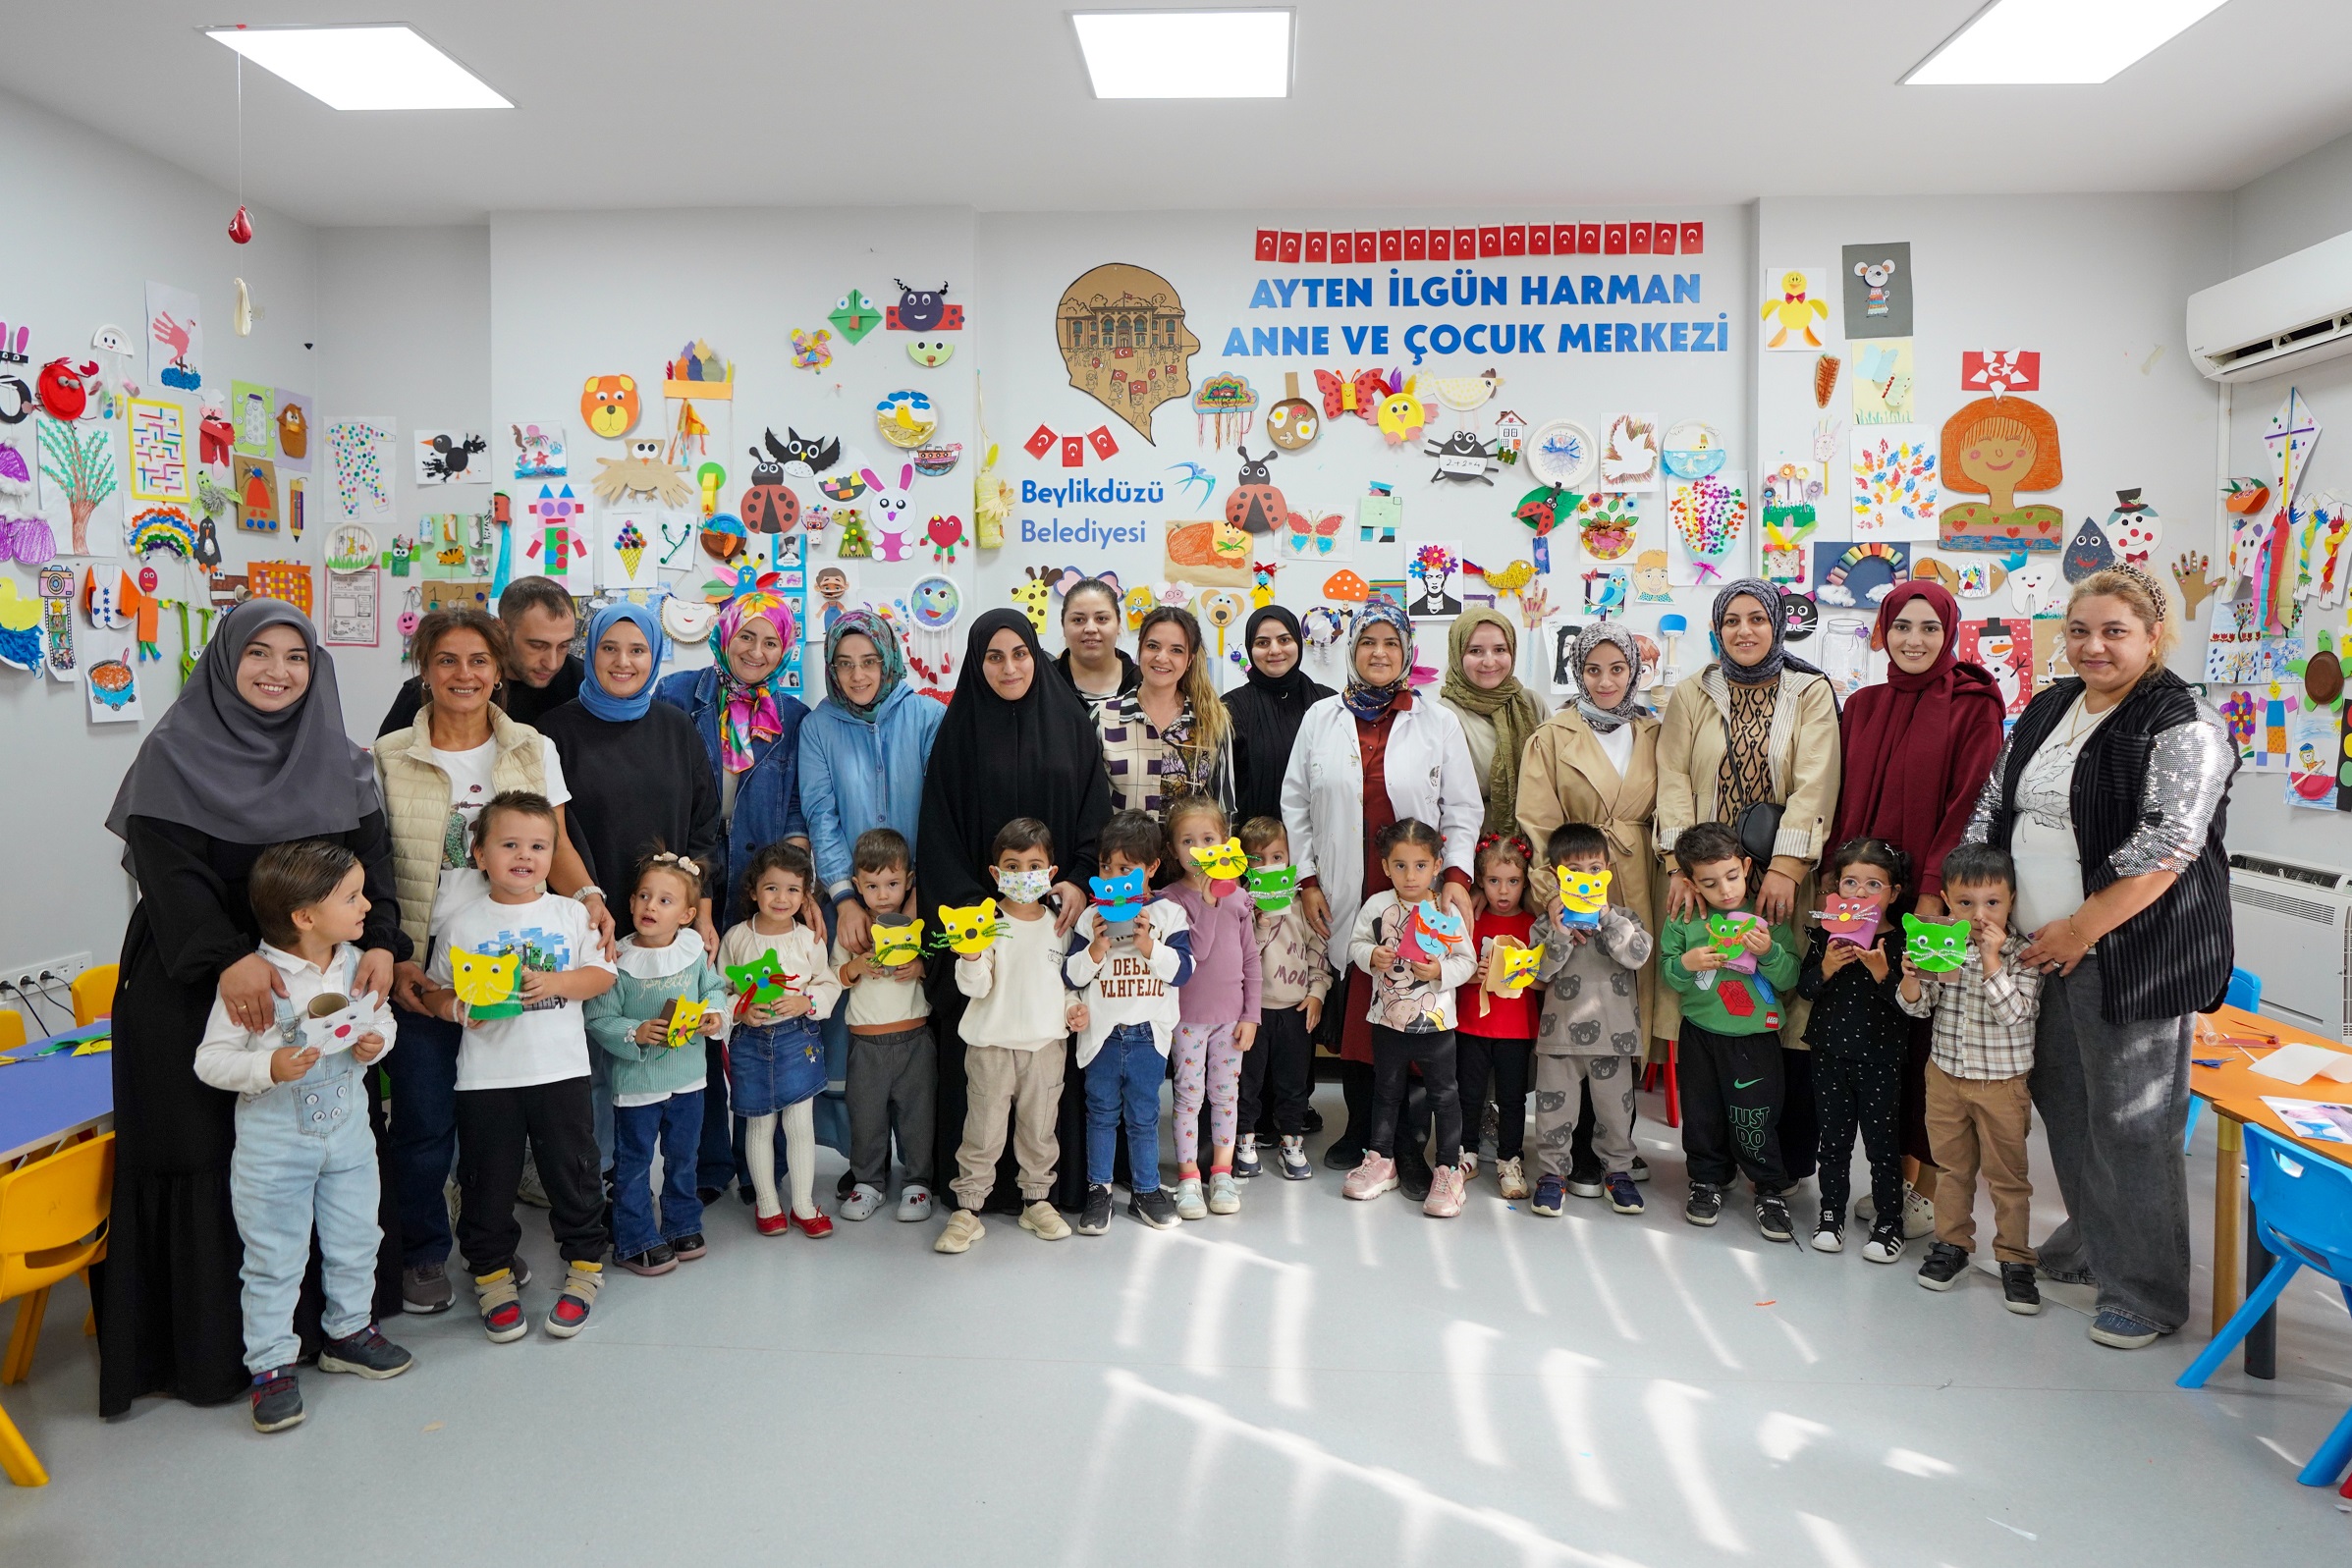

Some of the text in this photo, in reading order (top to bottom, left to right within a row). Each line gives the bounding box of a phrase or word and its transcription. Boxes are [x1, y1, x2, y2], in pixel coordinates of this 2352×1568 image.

[1249, 268, 1701, 308] AYTEN İLGÜN HARMAN
[1222, 312, 1728, 366] ANNE VE ÇOCUK MERKEZİ
[1021, 477, 1164, 509] Beylikdüzü
[1021, 517, 1146, 550] Belediyesi
[428, 586, 441, 602] 1
[455, 585, 470, 600] 2
[1729, 1105, 1770, 1129] JUST
[1735, 1125, 1766, 1148] DO
